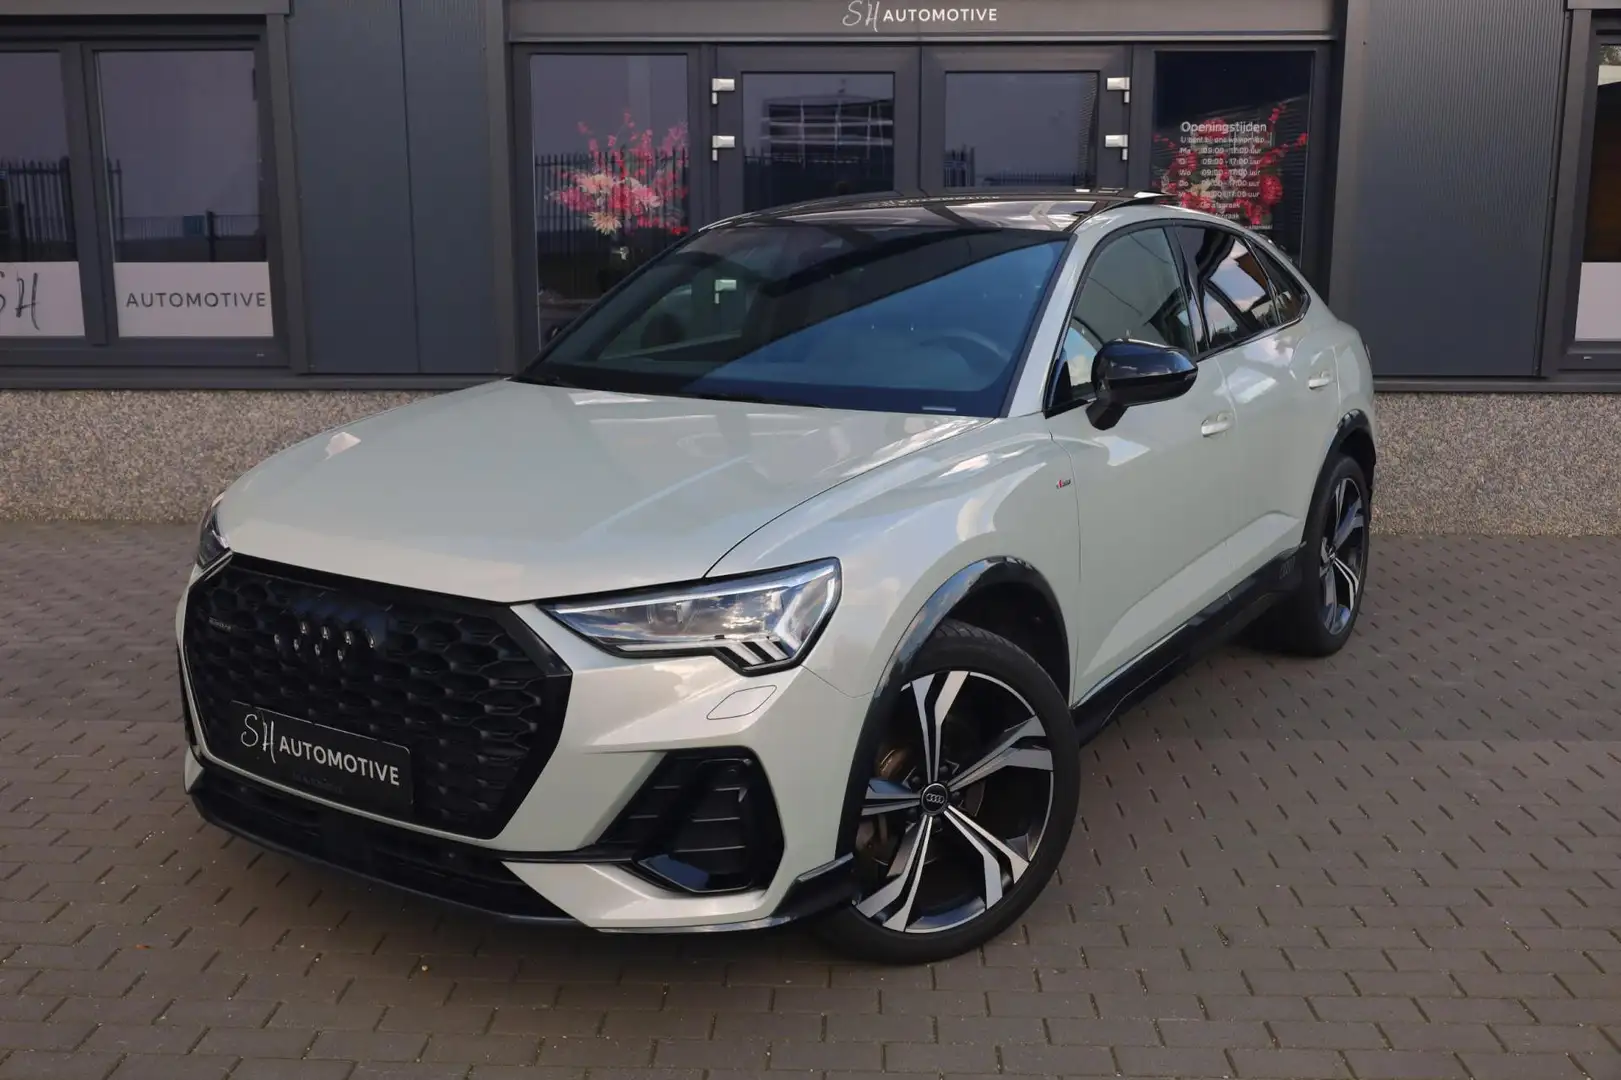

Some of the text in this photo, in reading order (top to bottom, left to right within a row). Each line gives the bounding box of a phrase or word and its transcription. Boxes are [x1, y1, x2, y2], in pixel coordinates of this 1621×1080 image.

[842, 0, 998, 32] SH AUTOMOTIVE
[1181, 121, 1267, 134] Openingstijden
[0, 271, 40, 330] H
[126, 292, 266, 308] AUTOMOTIVE
[240, 711, 277, 764] SH
[279, 735, 400, 786] AUTOMOTIVE
